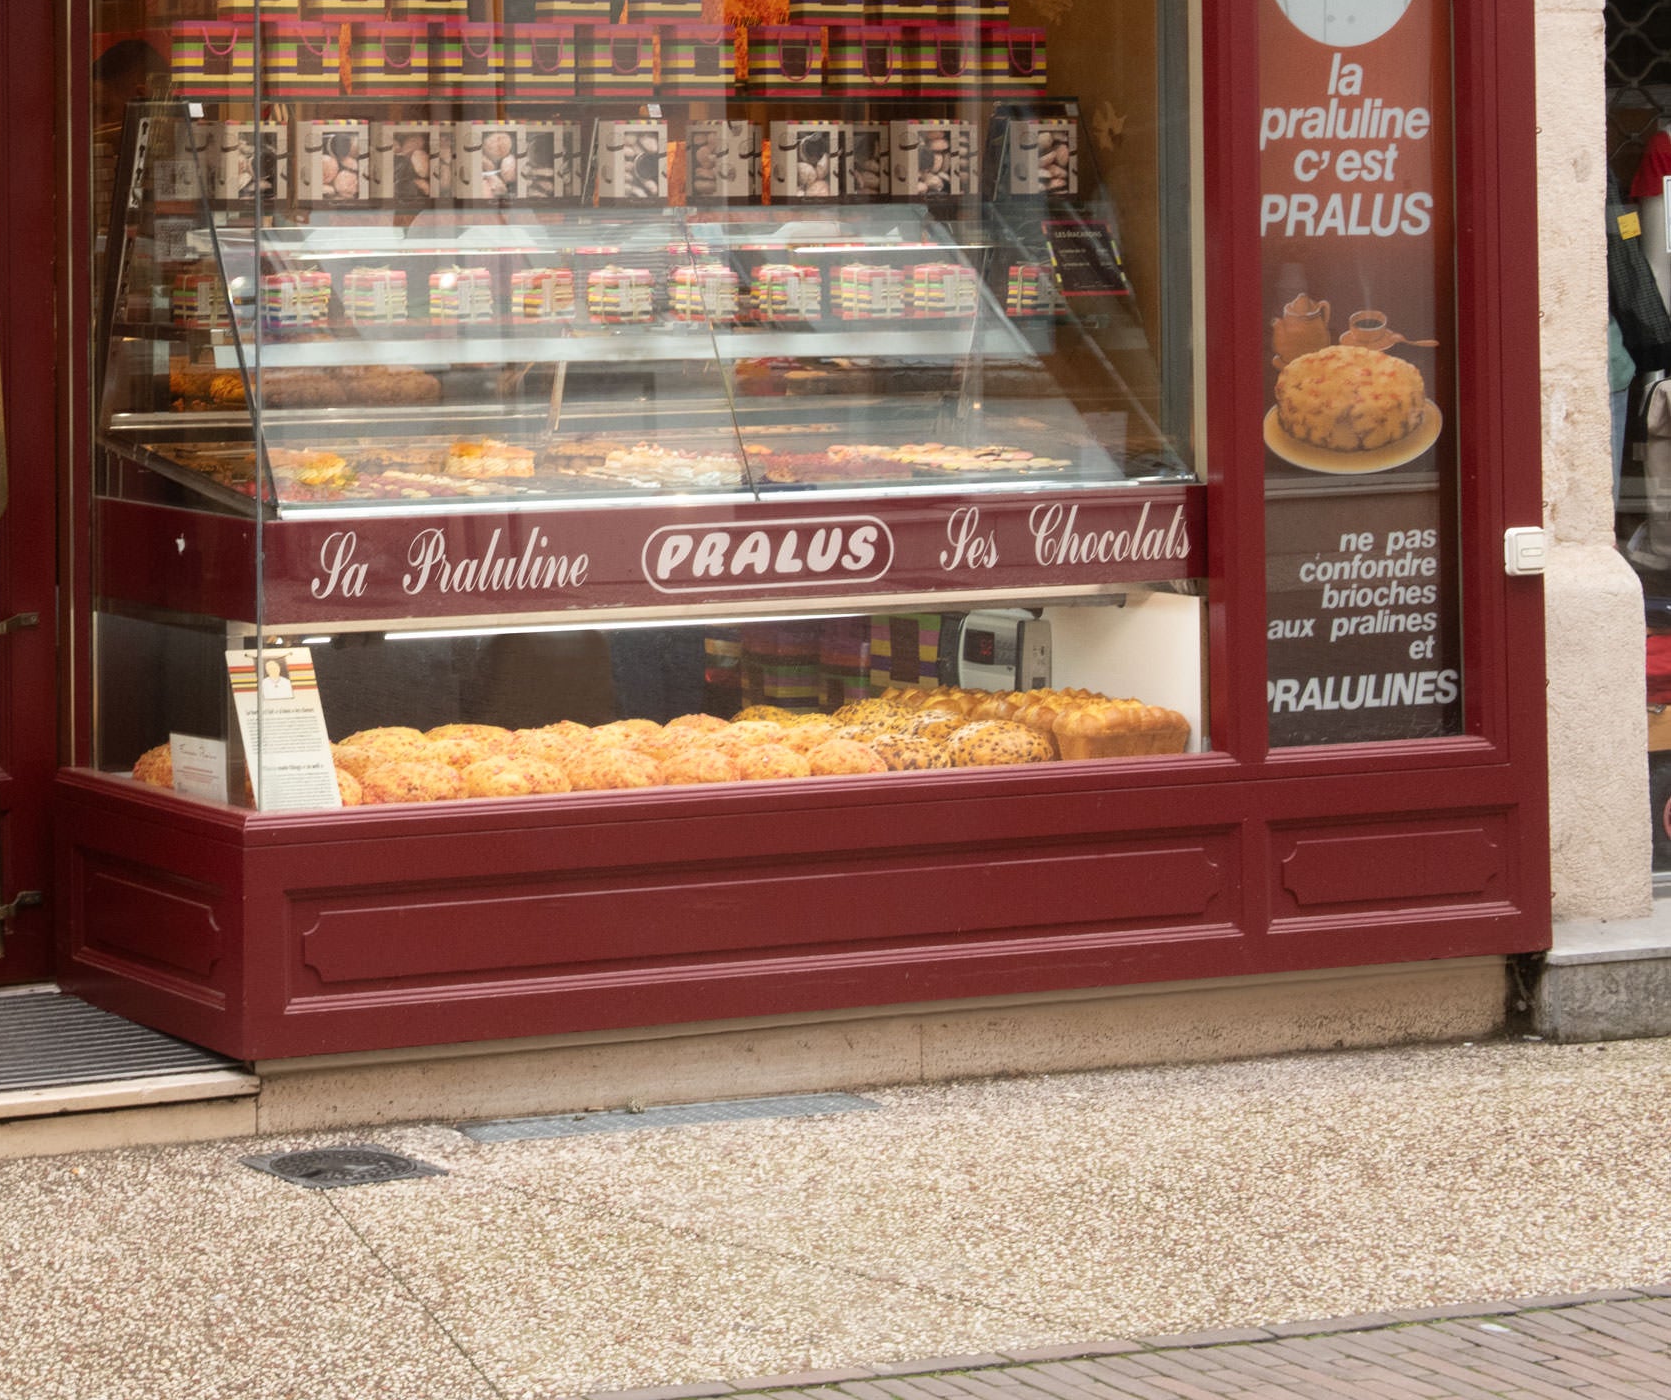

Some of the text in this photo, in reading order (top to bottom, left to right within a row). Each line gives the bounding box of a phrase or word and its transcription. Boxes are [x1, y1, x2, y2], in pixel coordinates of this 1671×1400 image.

[1327, 52, 1364, 96] la
[1259, 98, 1430, 151] praluline
[1294, 143, 1398, 182] c'est
[1260, 191, 1434, 237] PRALUS
[402, 526, 589, 595] Praluline
[657, 526, 878, 580] PRALUS
[940, 506, 1000, 571] Ses
[1029, 501, 1191, 566] Chocolats
[1339, 529, 1437, 556] ne pas
[1299, 552, 1437, 583] confondre
[1321, 580, 1437, 609] brioches
[1267, 610, 1438, 642] aux pralines
[1408, 635, 1435, 660] et
